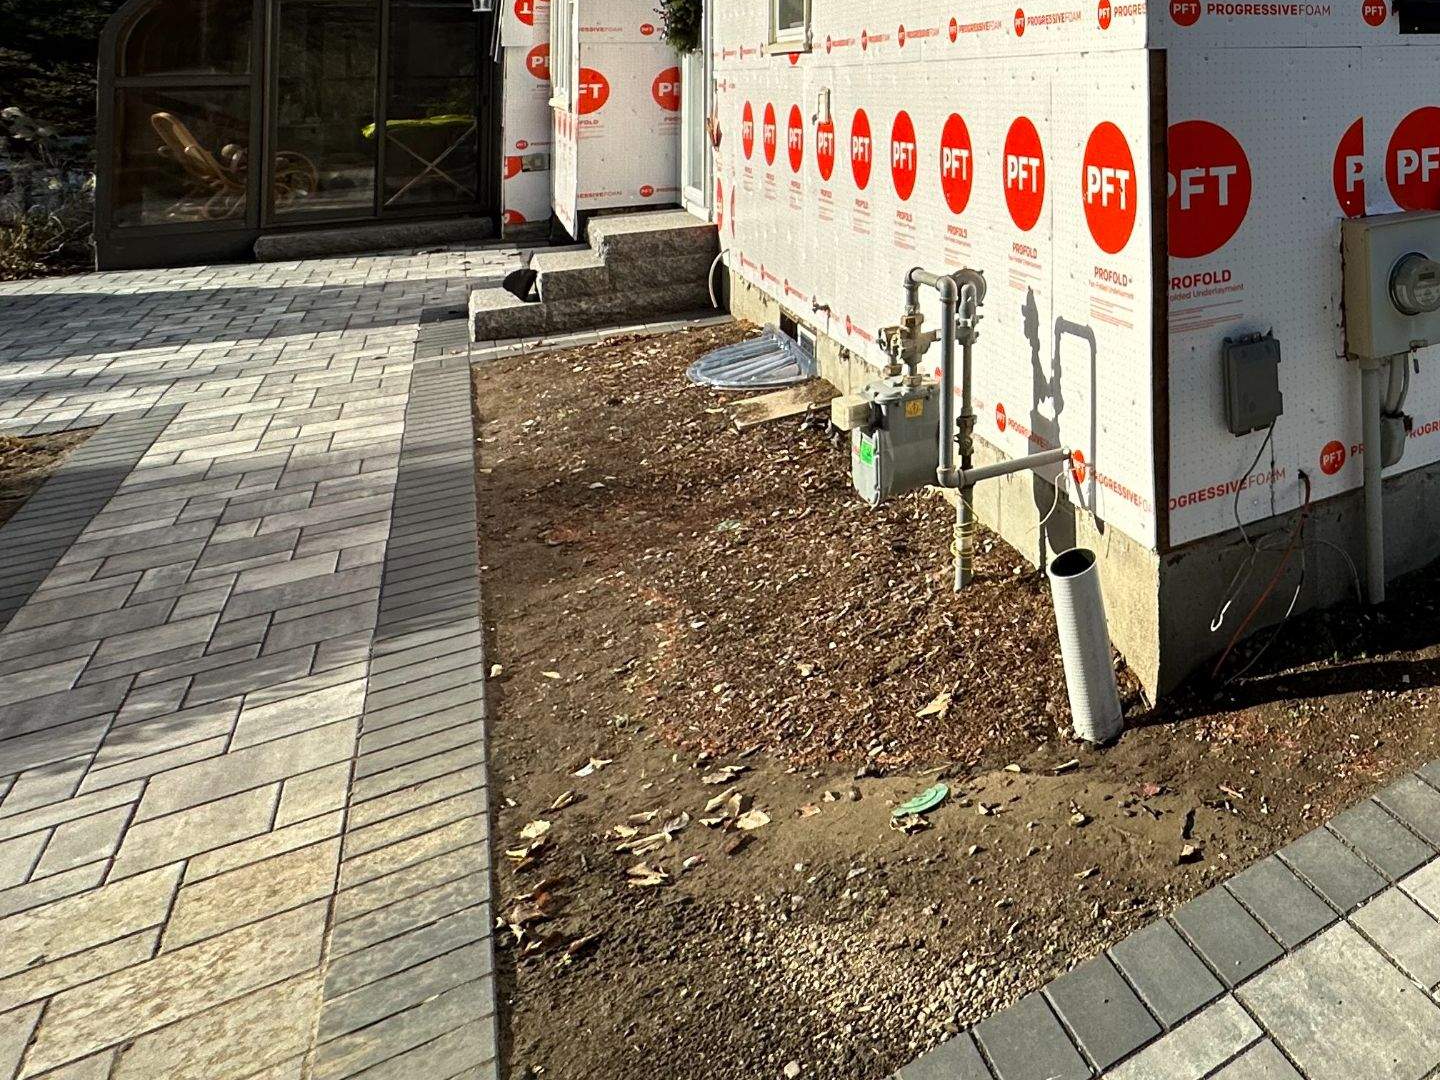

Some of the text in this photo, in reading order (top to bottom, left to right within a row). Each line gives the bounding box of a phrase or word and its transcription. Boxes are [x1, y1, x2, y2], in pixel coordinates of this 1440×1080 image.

[1027, 10, 1081, 27] PROGRESSIVEFOAM
[1172, 3, 1331, 17] PFT PROGRESSIVEFOAM
[1364, 5, 1384, 17] PFT
[788, 128, 803, 151] PFT
[818, 132, 833, 156] PFT
[852, 135, 870, 163] PFT
[893, 141, 915, 171] PFT
[942, 147, 969, 180] PFT
[1008, 155, 1040, 193] PFT
[1087, 166, 1130, 210] PFT
[947, 224, 968, 239] PROFOLD
[1012, 242, 1038, 260] PROFOLD
[1094, 265, 1128, 287] PROFOLD
[1192, 283, 1245, 298] Underlayment
[1323, 451, 1343, 466] PFT
